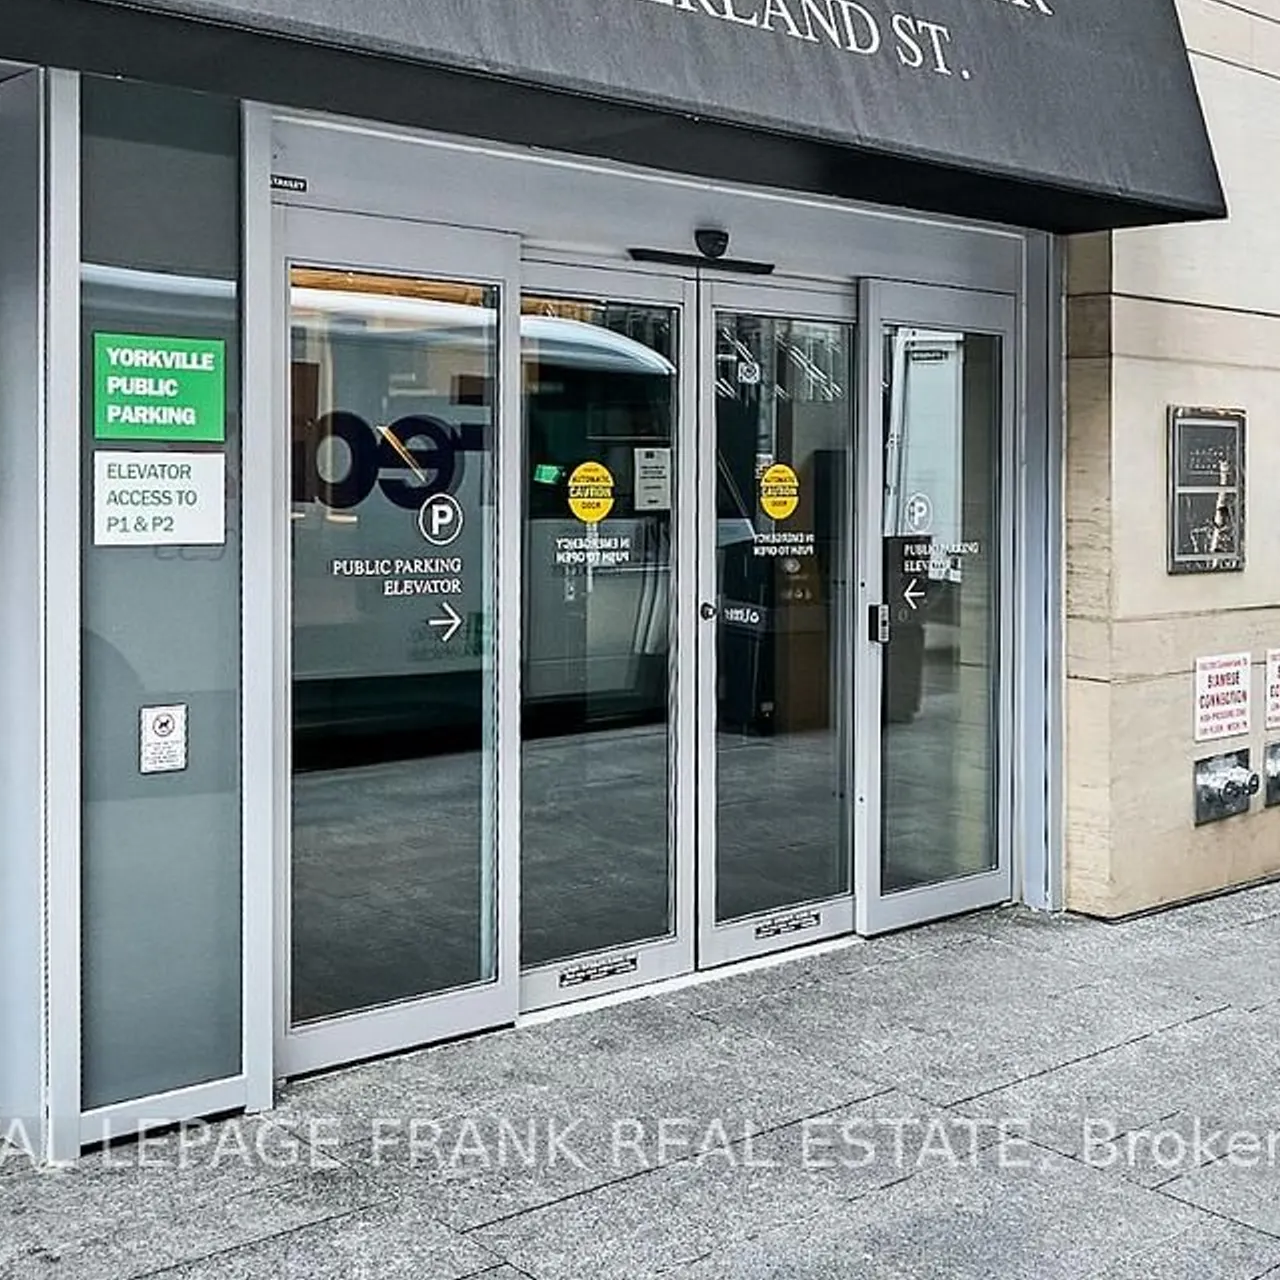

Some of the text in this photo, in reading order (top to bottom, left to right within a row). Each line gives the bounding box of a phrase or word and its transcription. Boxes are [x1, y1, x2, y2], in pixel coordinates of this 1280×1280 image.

[891, 14, 972, 81] ST.
[106, 347, 215, 371] YORKVILLE
[107, 376, 179, 397] PUBLIC
[107, 404, 196, 425] PARKING
[107, 463, 192, 480] ELEVATOR
[107, 489, 198, 506] ACCESS TO
[107, 516, 174, 533] P1 & P2
[333, 558, 461, 575] PUBLIC PARKING
[384, 579, 462, 595] ELEVATOR
